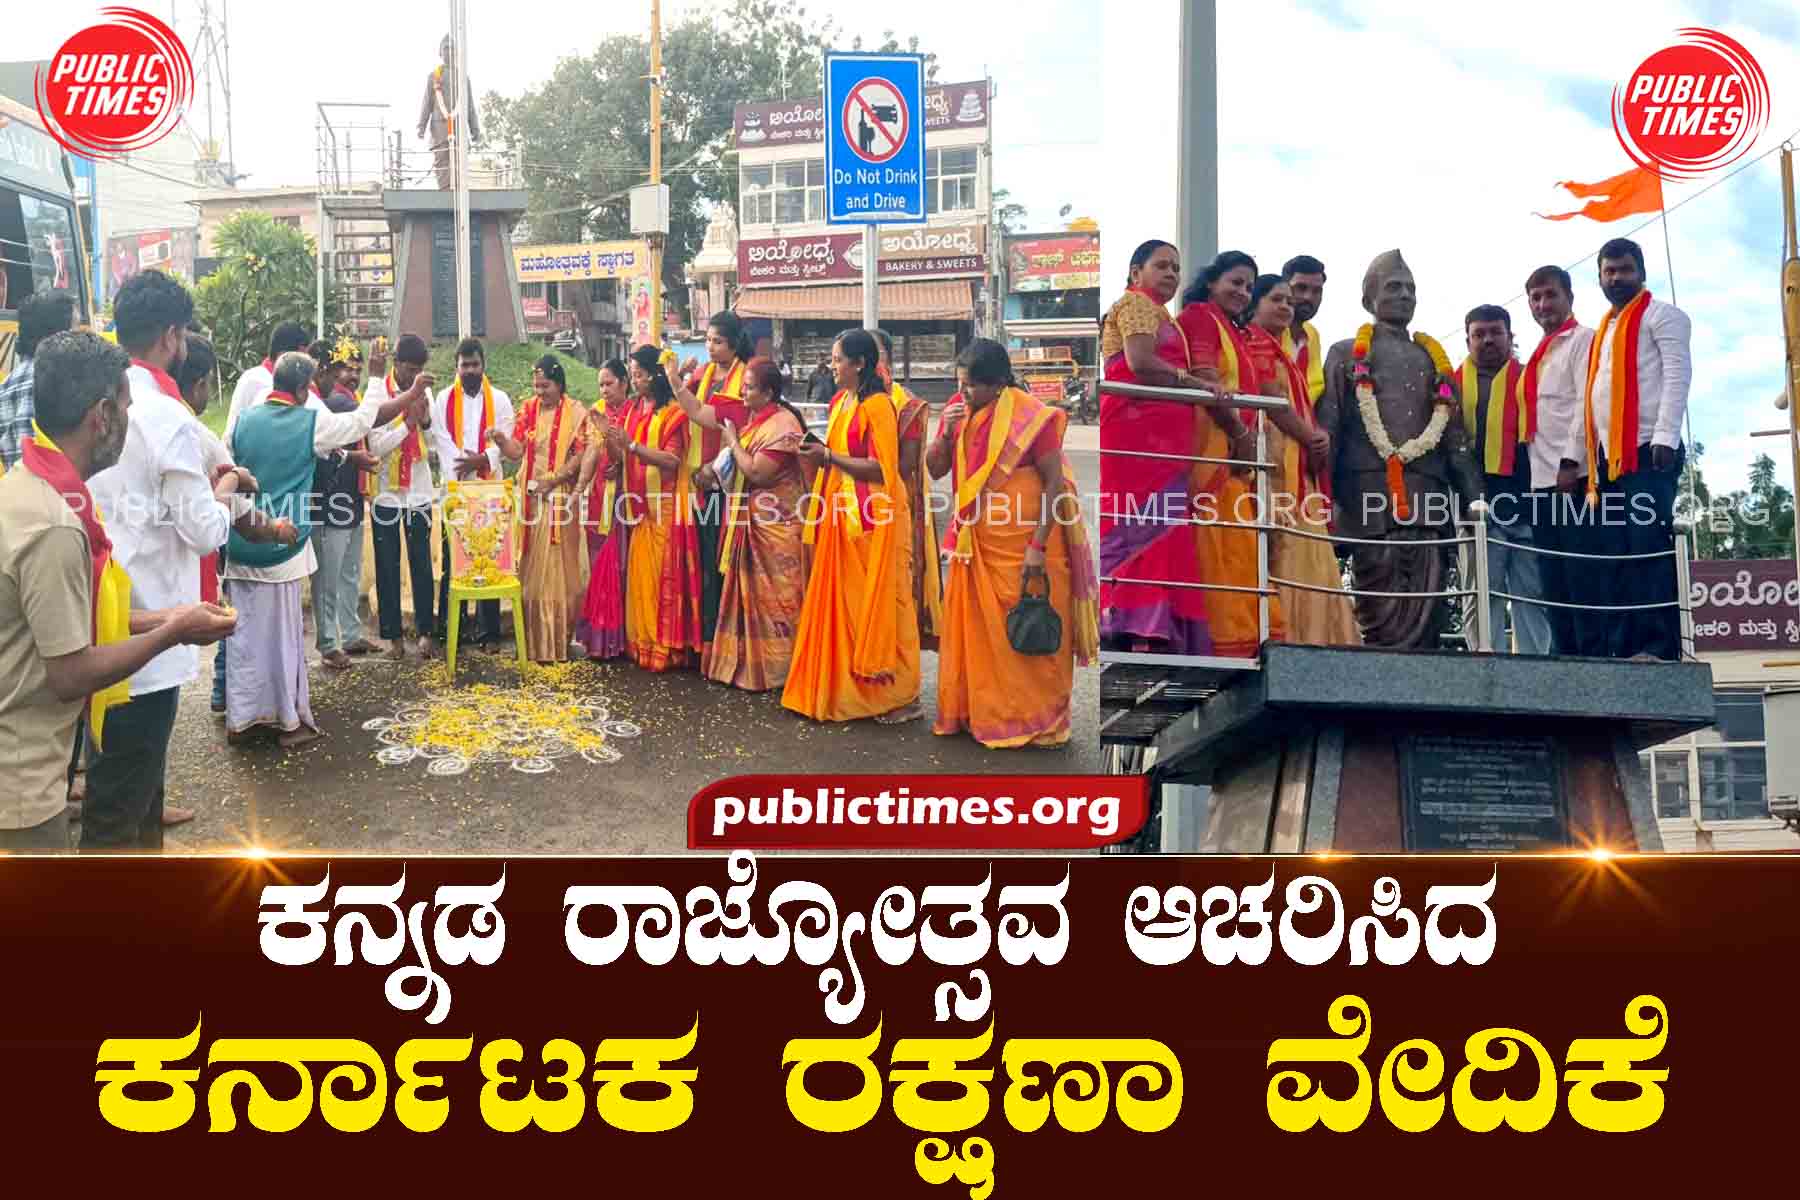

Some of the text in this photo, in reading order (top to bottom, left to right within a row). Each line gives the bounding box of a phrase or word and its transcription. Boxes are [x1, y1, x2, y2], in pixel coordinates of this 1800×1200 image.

[834, 167, 918, 185] Do Not Drink
[845, 192, 906, 209] and Drive
[748, 237, 835, 265] ಅಯೋಧ್ಯ
[885, 257, 977, 272] BAKERY & SWEETS
[1738, 619, 1777, 641] ಮತ್ತು
